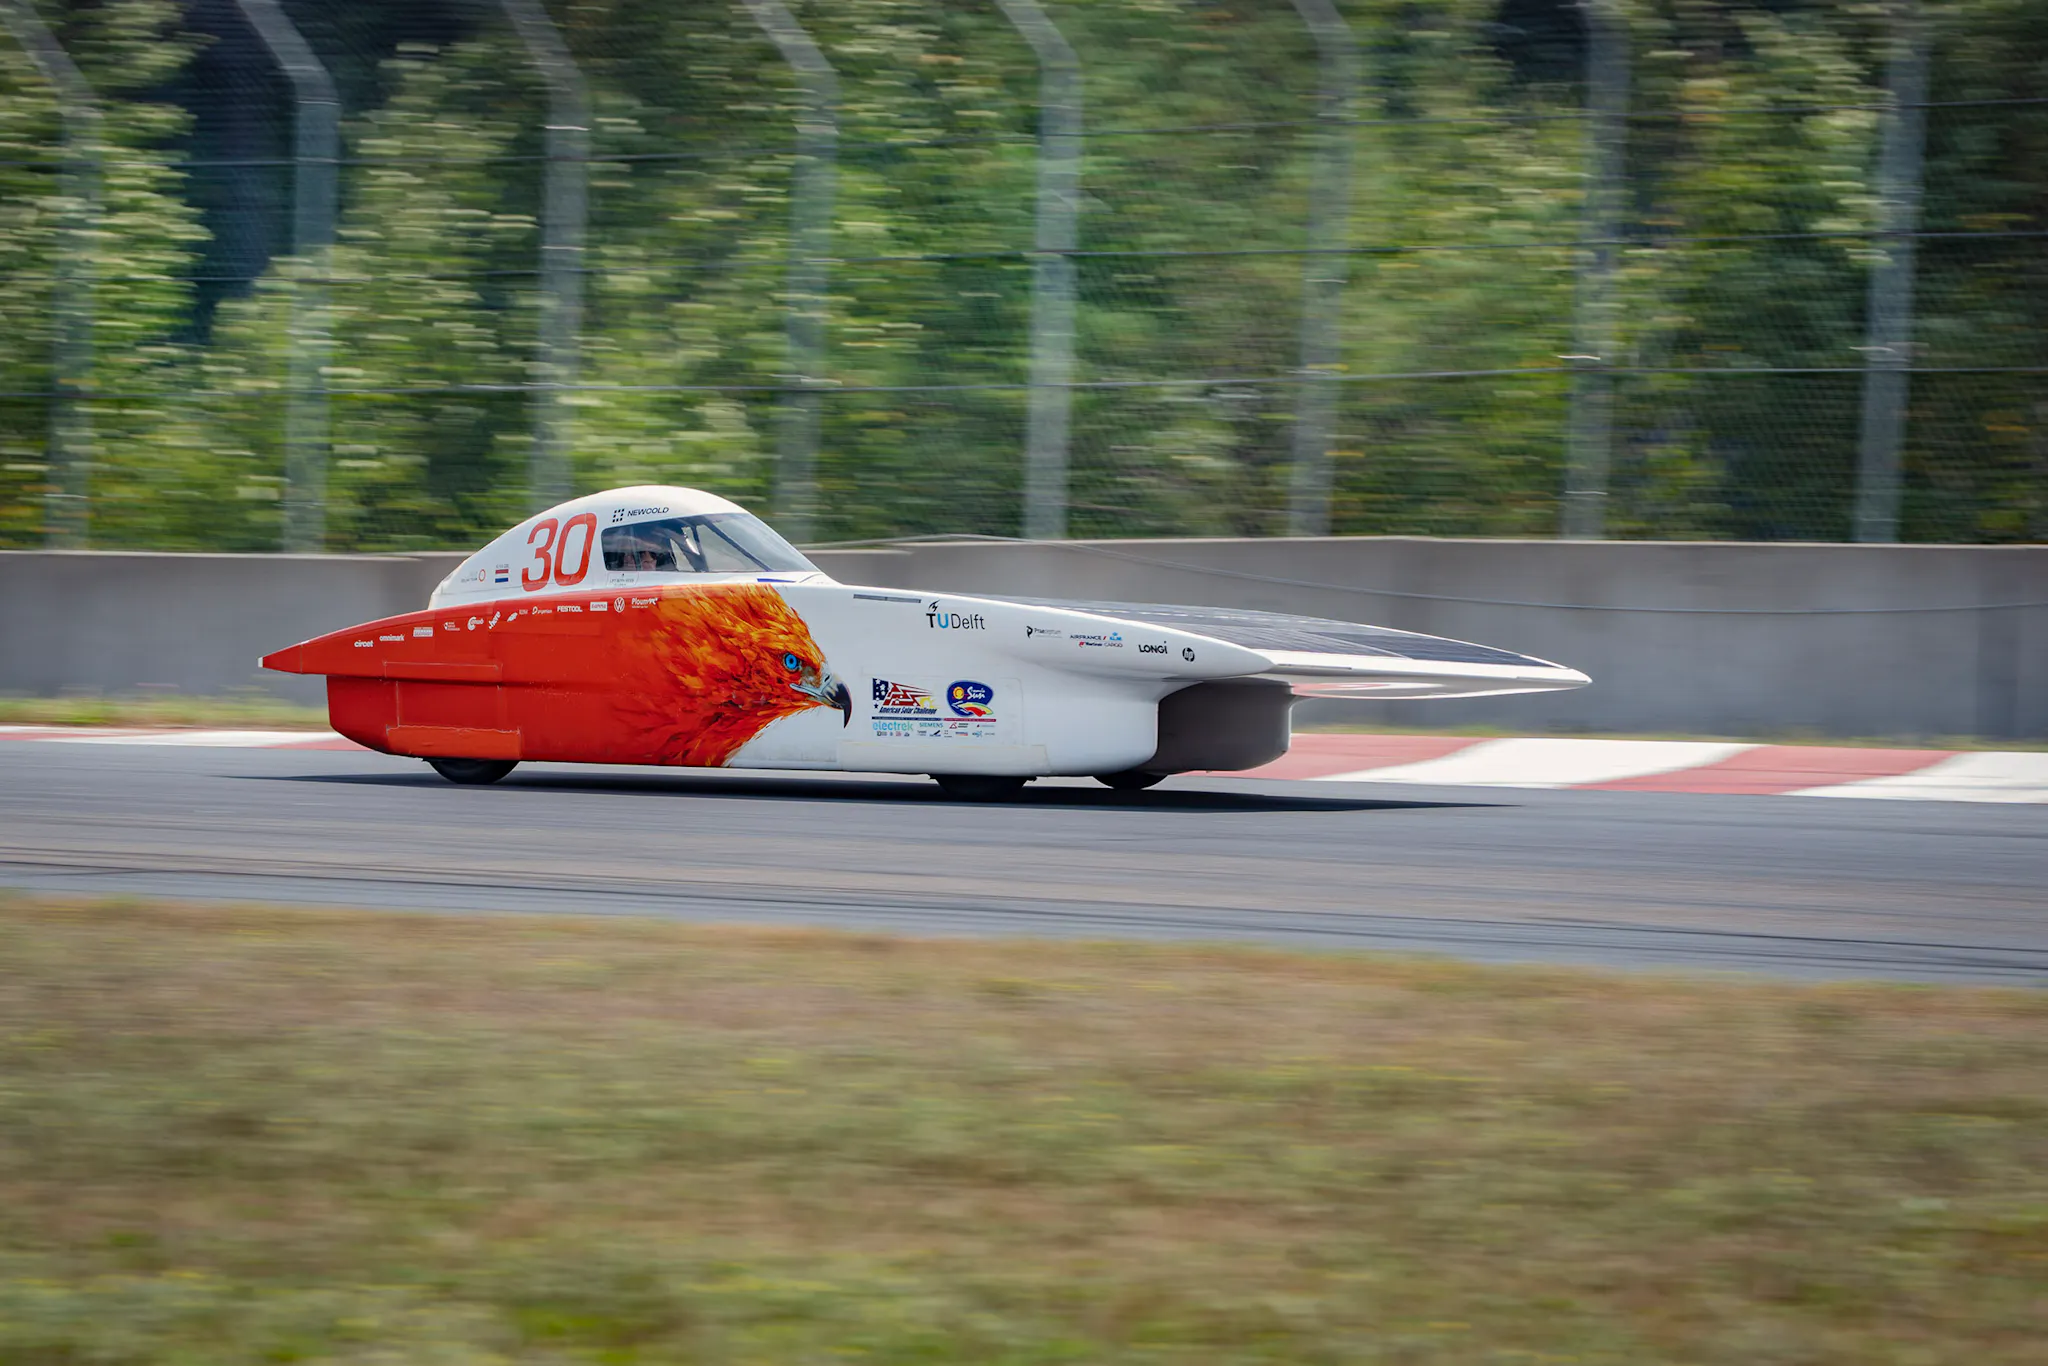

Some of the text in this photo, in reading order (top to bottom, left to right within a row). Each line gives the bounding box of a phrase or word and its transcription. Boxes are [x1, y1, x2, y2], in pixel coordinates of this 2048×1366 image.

[627, 507, 669, 517] NEWCOLD
[521, 512, 598, 592] 30
[556, 605, 583, 613] FESTOOL
[354, 640, 374, 648] circet
[1182, 647, 1195, 662] hp
[879, 706, 938, 715] American Solar Challenge
[872, 721, 914, 731] electrek
